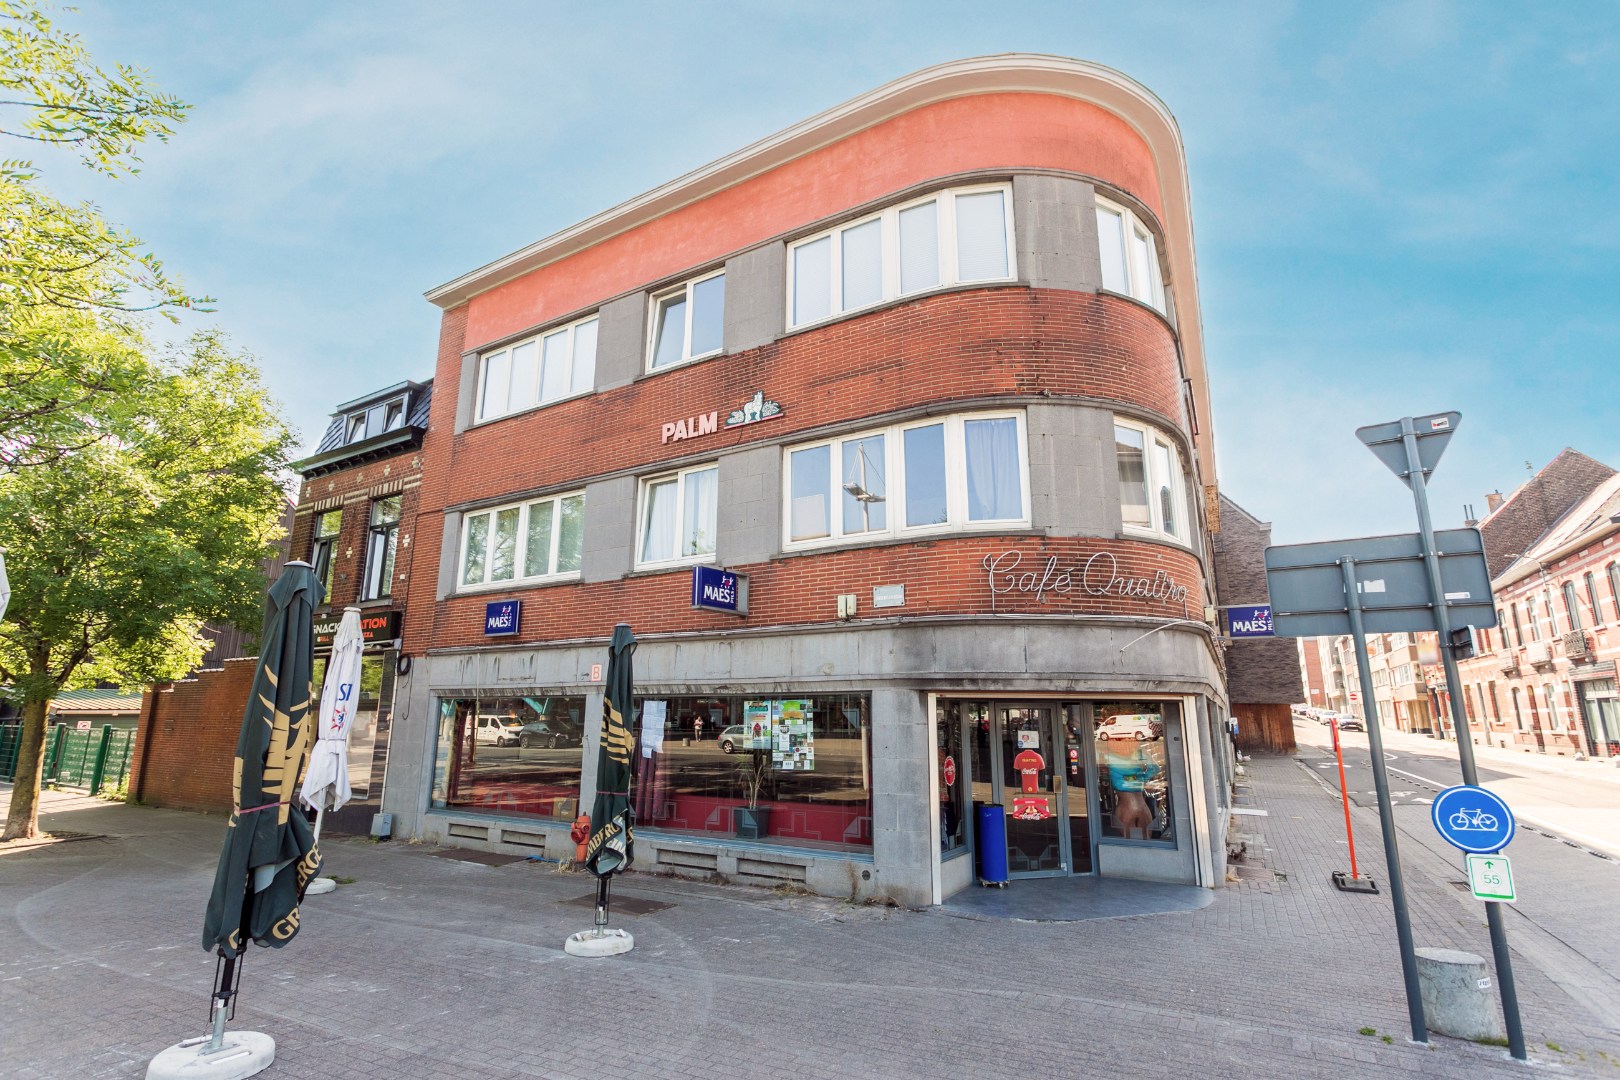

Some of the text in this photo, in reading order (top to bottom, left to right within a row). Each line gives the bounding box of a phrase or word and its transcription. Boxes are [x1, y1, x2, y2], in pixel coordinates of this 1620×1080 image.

[661, 411, 718, 444] PALM
[983, 550, 1190, 602] Café Quattro
[703, 585, 730, 603] MAES
[487, 616, 508, 628] MAES
[1232, 620, 1267, 632] MAES
[1483, 874, 1500, 885] 55
